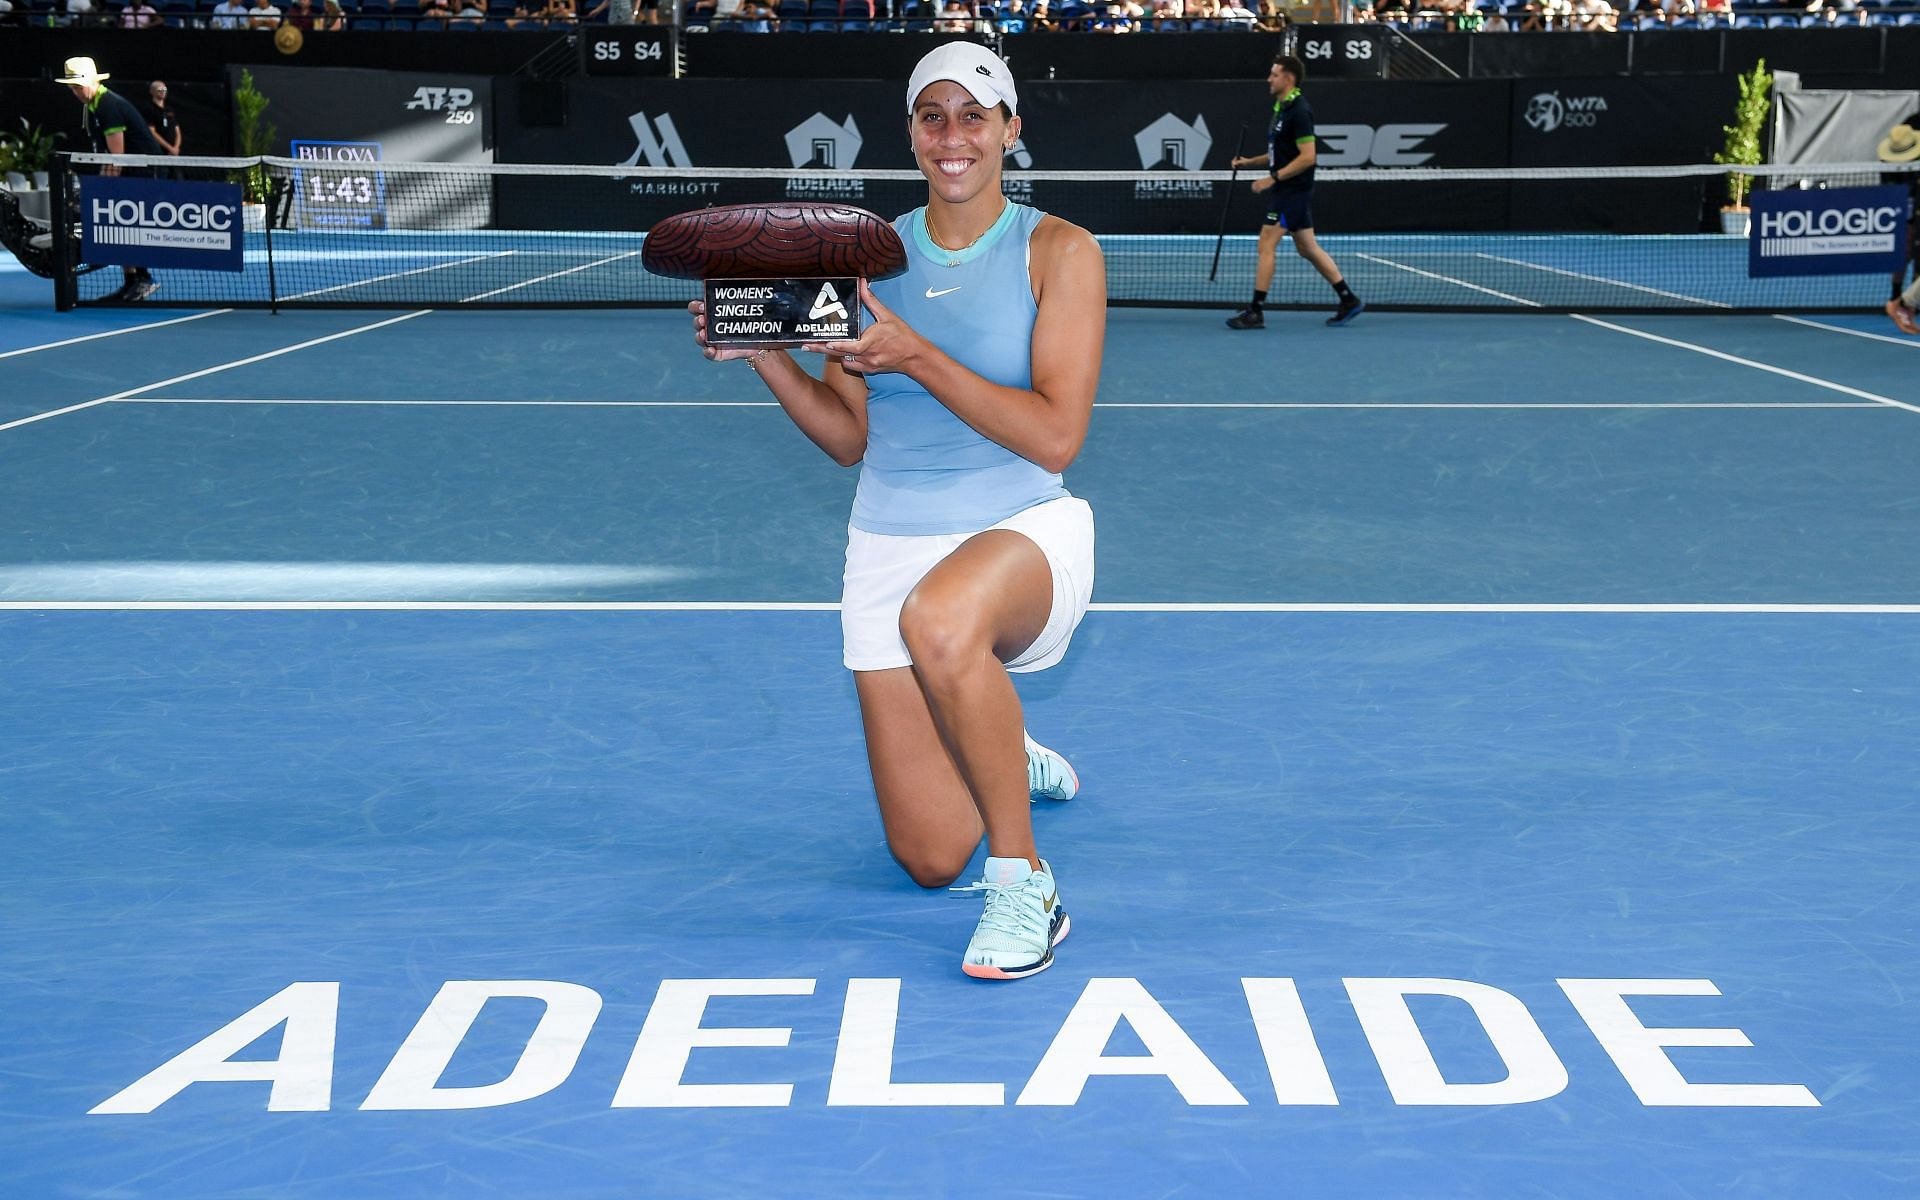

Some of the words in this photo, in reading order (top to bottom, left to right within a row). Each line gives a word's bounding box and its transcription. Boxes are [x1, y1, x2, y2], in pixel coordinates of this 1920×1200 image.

[594, 41, 621, 60] S5
[634, 41, 662, 60] S4
[1305, 40, 1333, 59] S4
[1345, 40, 1372, 59] S3
[404, 87, 474, 110] ATP
[1565, 96, 1608, 111] WTA
[445, 110, 475, 124] 250
[1564, 112, 1597, 127] 500
[299, 146, 375, 161] BULOVA
[309, 175, 372, 203] 1:43
[630, 182, 720, 194] MARRIOTT
[145, 233, 161, 241] The
[162, 234, 195, 243] Science
[206, 237, 226, 245] Sure
[714, 287, 774, 300] WOMEN'S
[714, 304, 764, 317] SINGLES
[715, 321, 782, 334] CHAMPION
[795, 323, 849, 332] ADELAIDE
[88, 977, 1822, 1114] ADELAIDE
